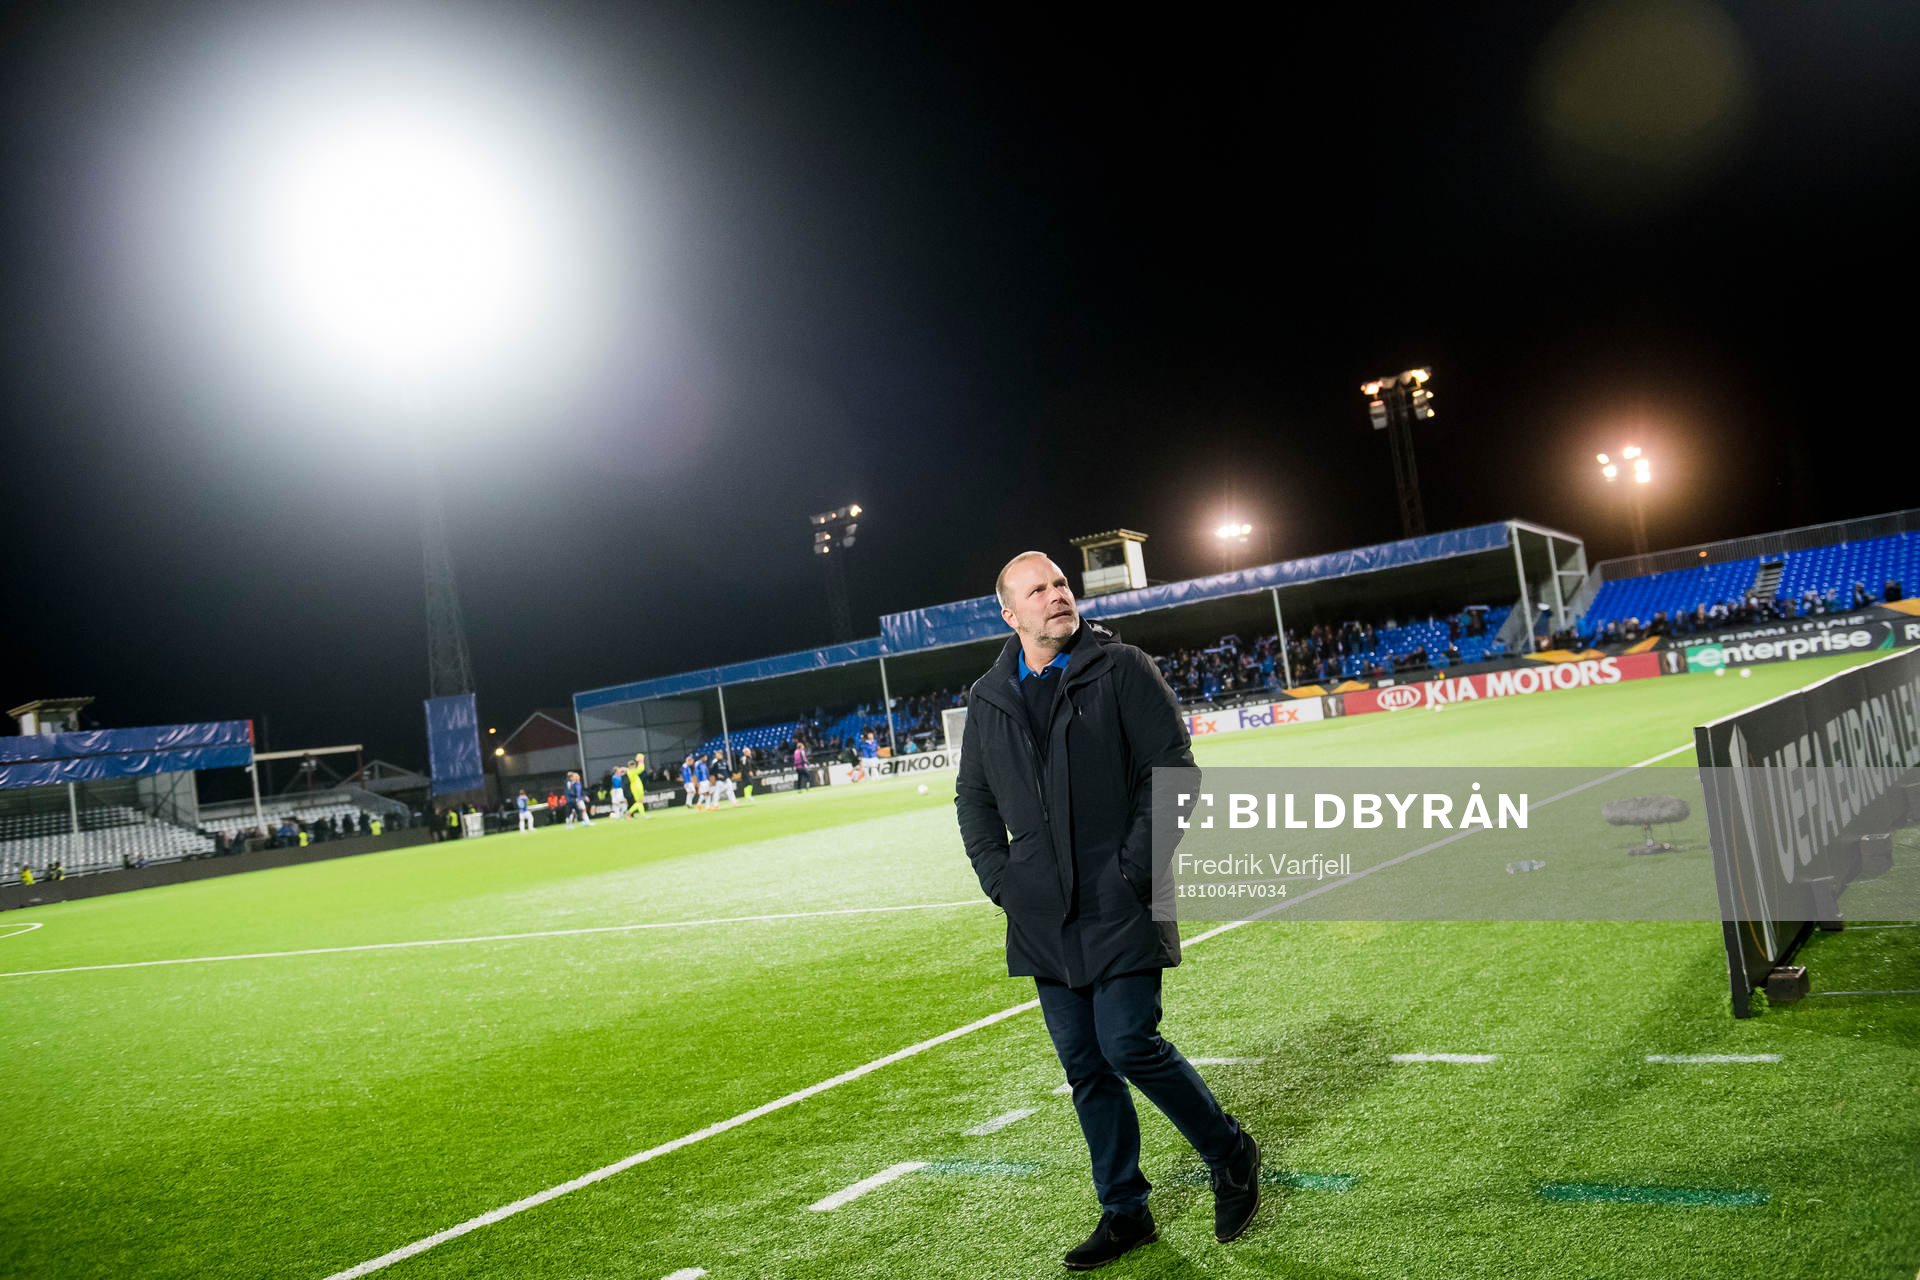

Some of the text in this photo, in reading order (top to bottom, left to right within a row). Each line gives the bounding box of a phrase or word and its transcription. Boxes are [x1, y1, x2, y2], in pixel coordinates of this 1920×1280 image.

[1903, 622, 1920, 640] R
[1690, 629, 1872, 666] enterprise
[1384, 656, 1622, 707] KIA KIA MOTORS
[1185, 715, 1217, 736] dEx
[1238, 703, 1298, 729] FedEx
[868, 753, 951, 777] ankoo
[1763, 731, 1839, 884] UEFA
[1826, 693, 1905, 828] EUROPA
